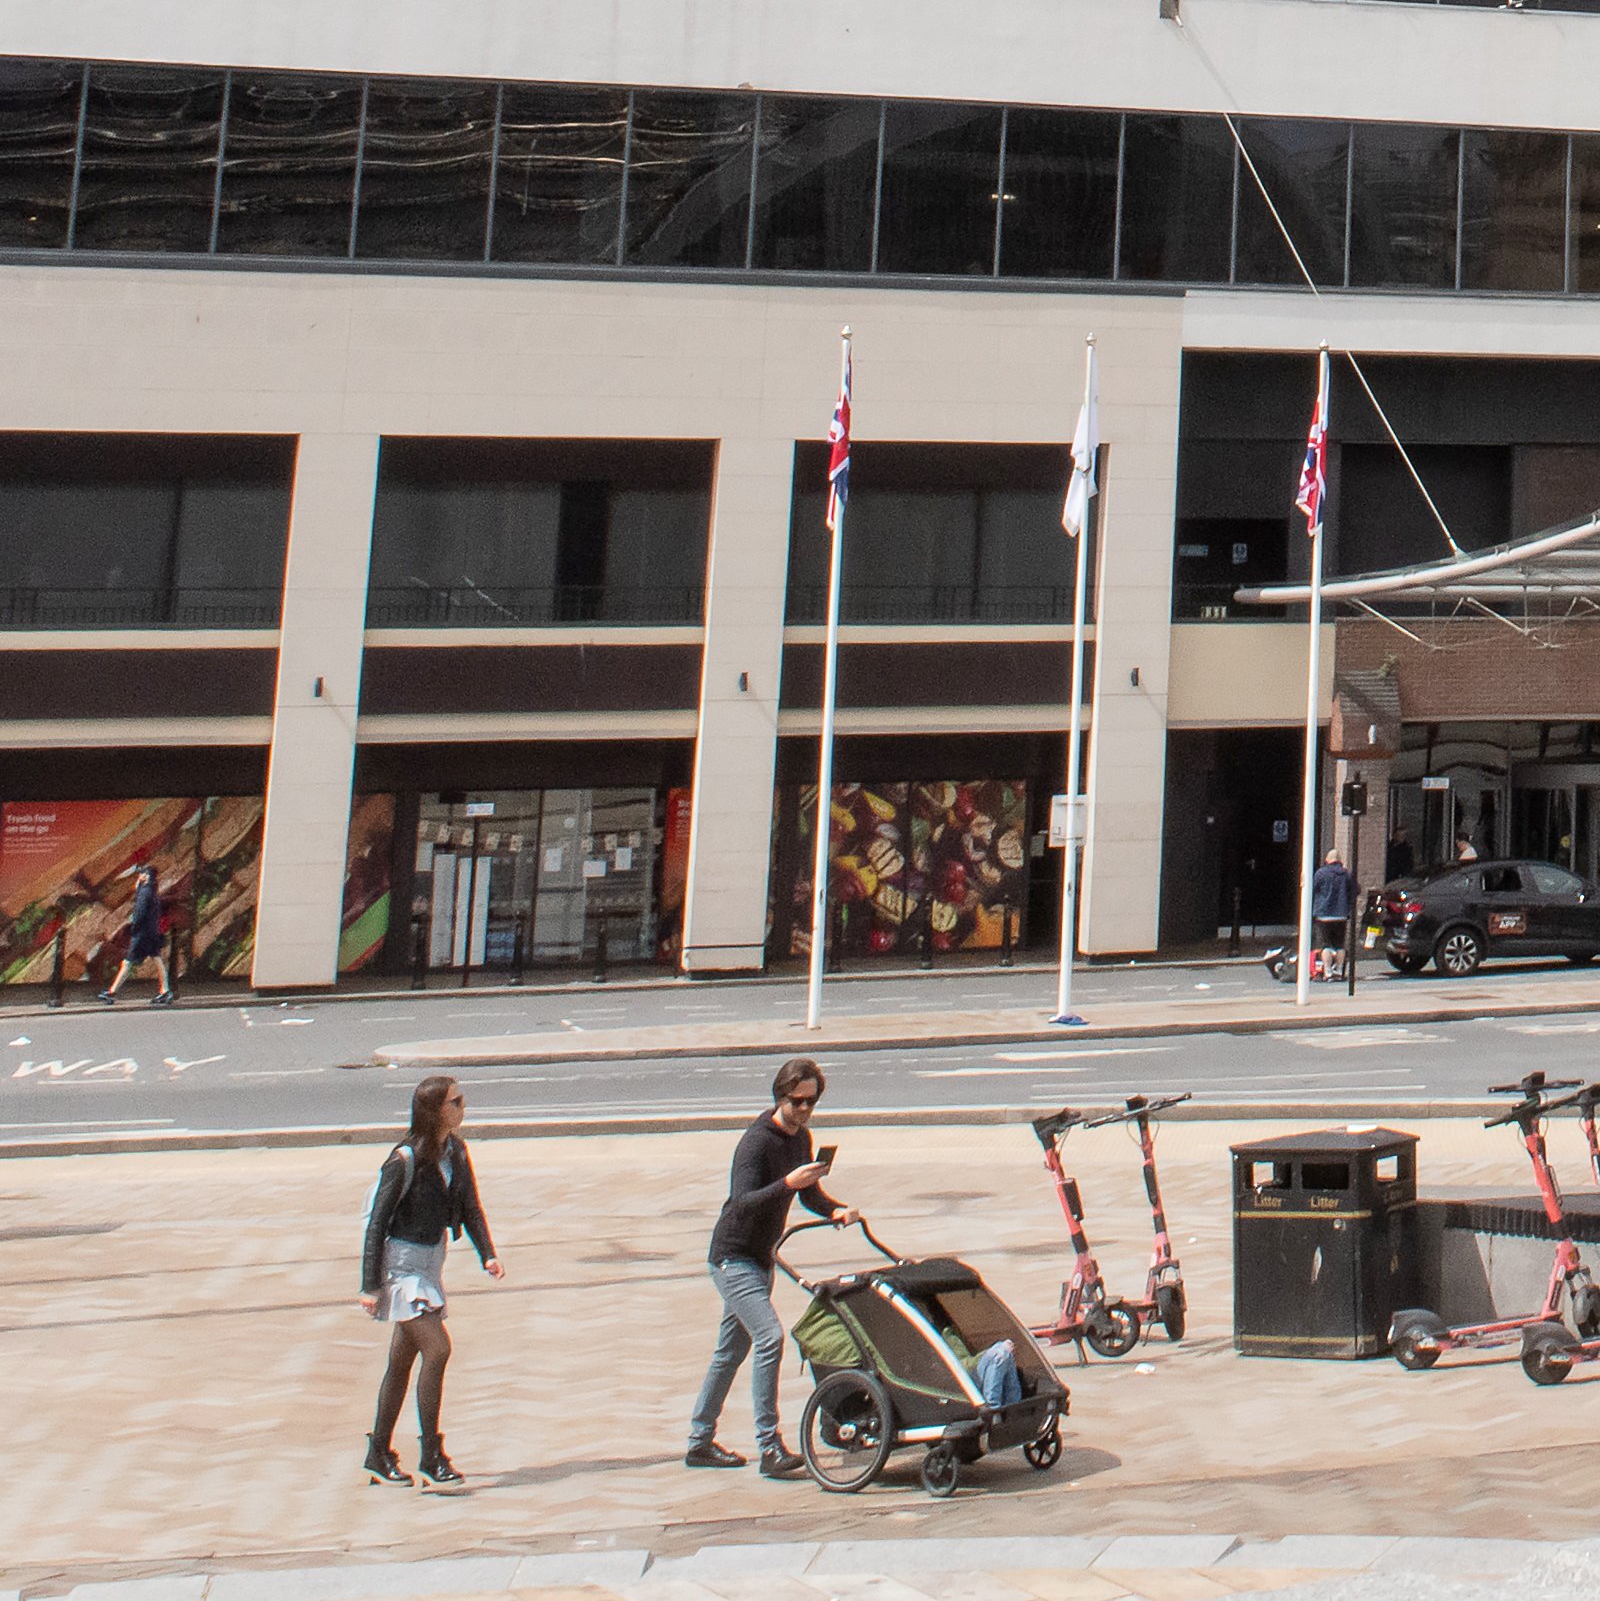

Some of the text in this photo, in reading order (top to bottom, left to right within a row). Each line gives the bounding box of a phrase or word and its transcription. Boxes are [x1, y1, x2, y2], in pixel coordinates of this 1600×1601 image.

[7, 814, 56, 823] Fresh food
[19, 825, 35, 833] the
[36, 826, 49, 835] go
[11, 1054, 227, 1080] WAY
[1254, 1197, 1282, 1208] Litter
[1310, 1197, 1340, 1209] Litter
